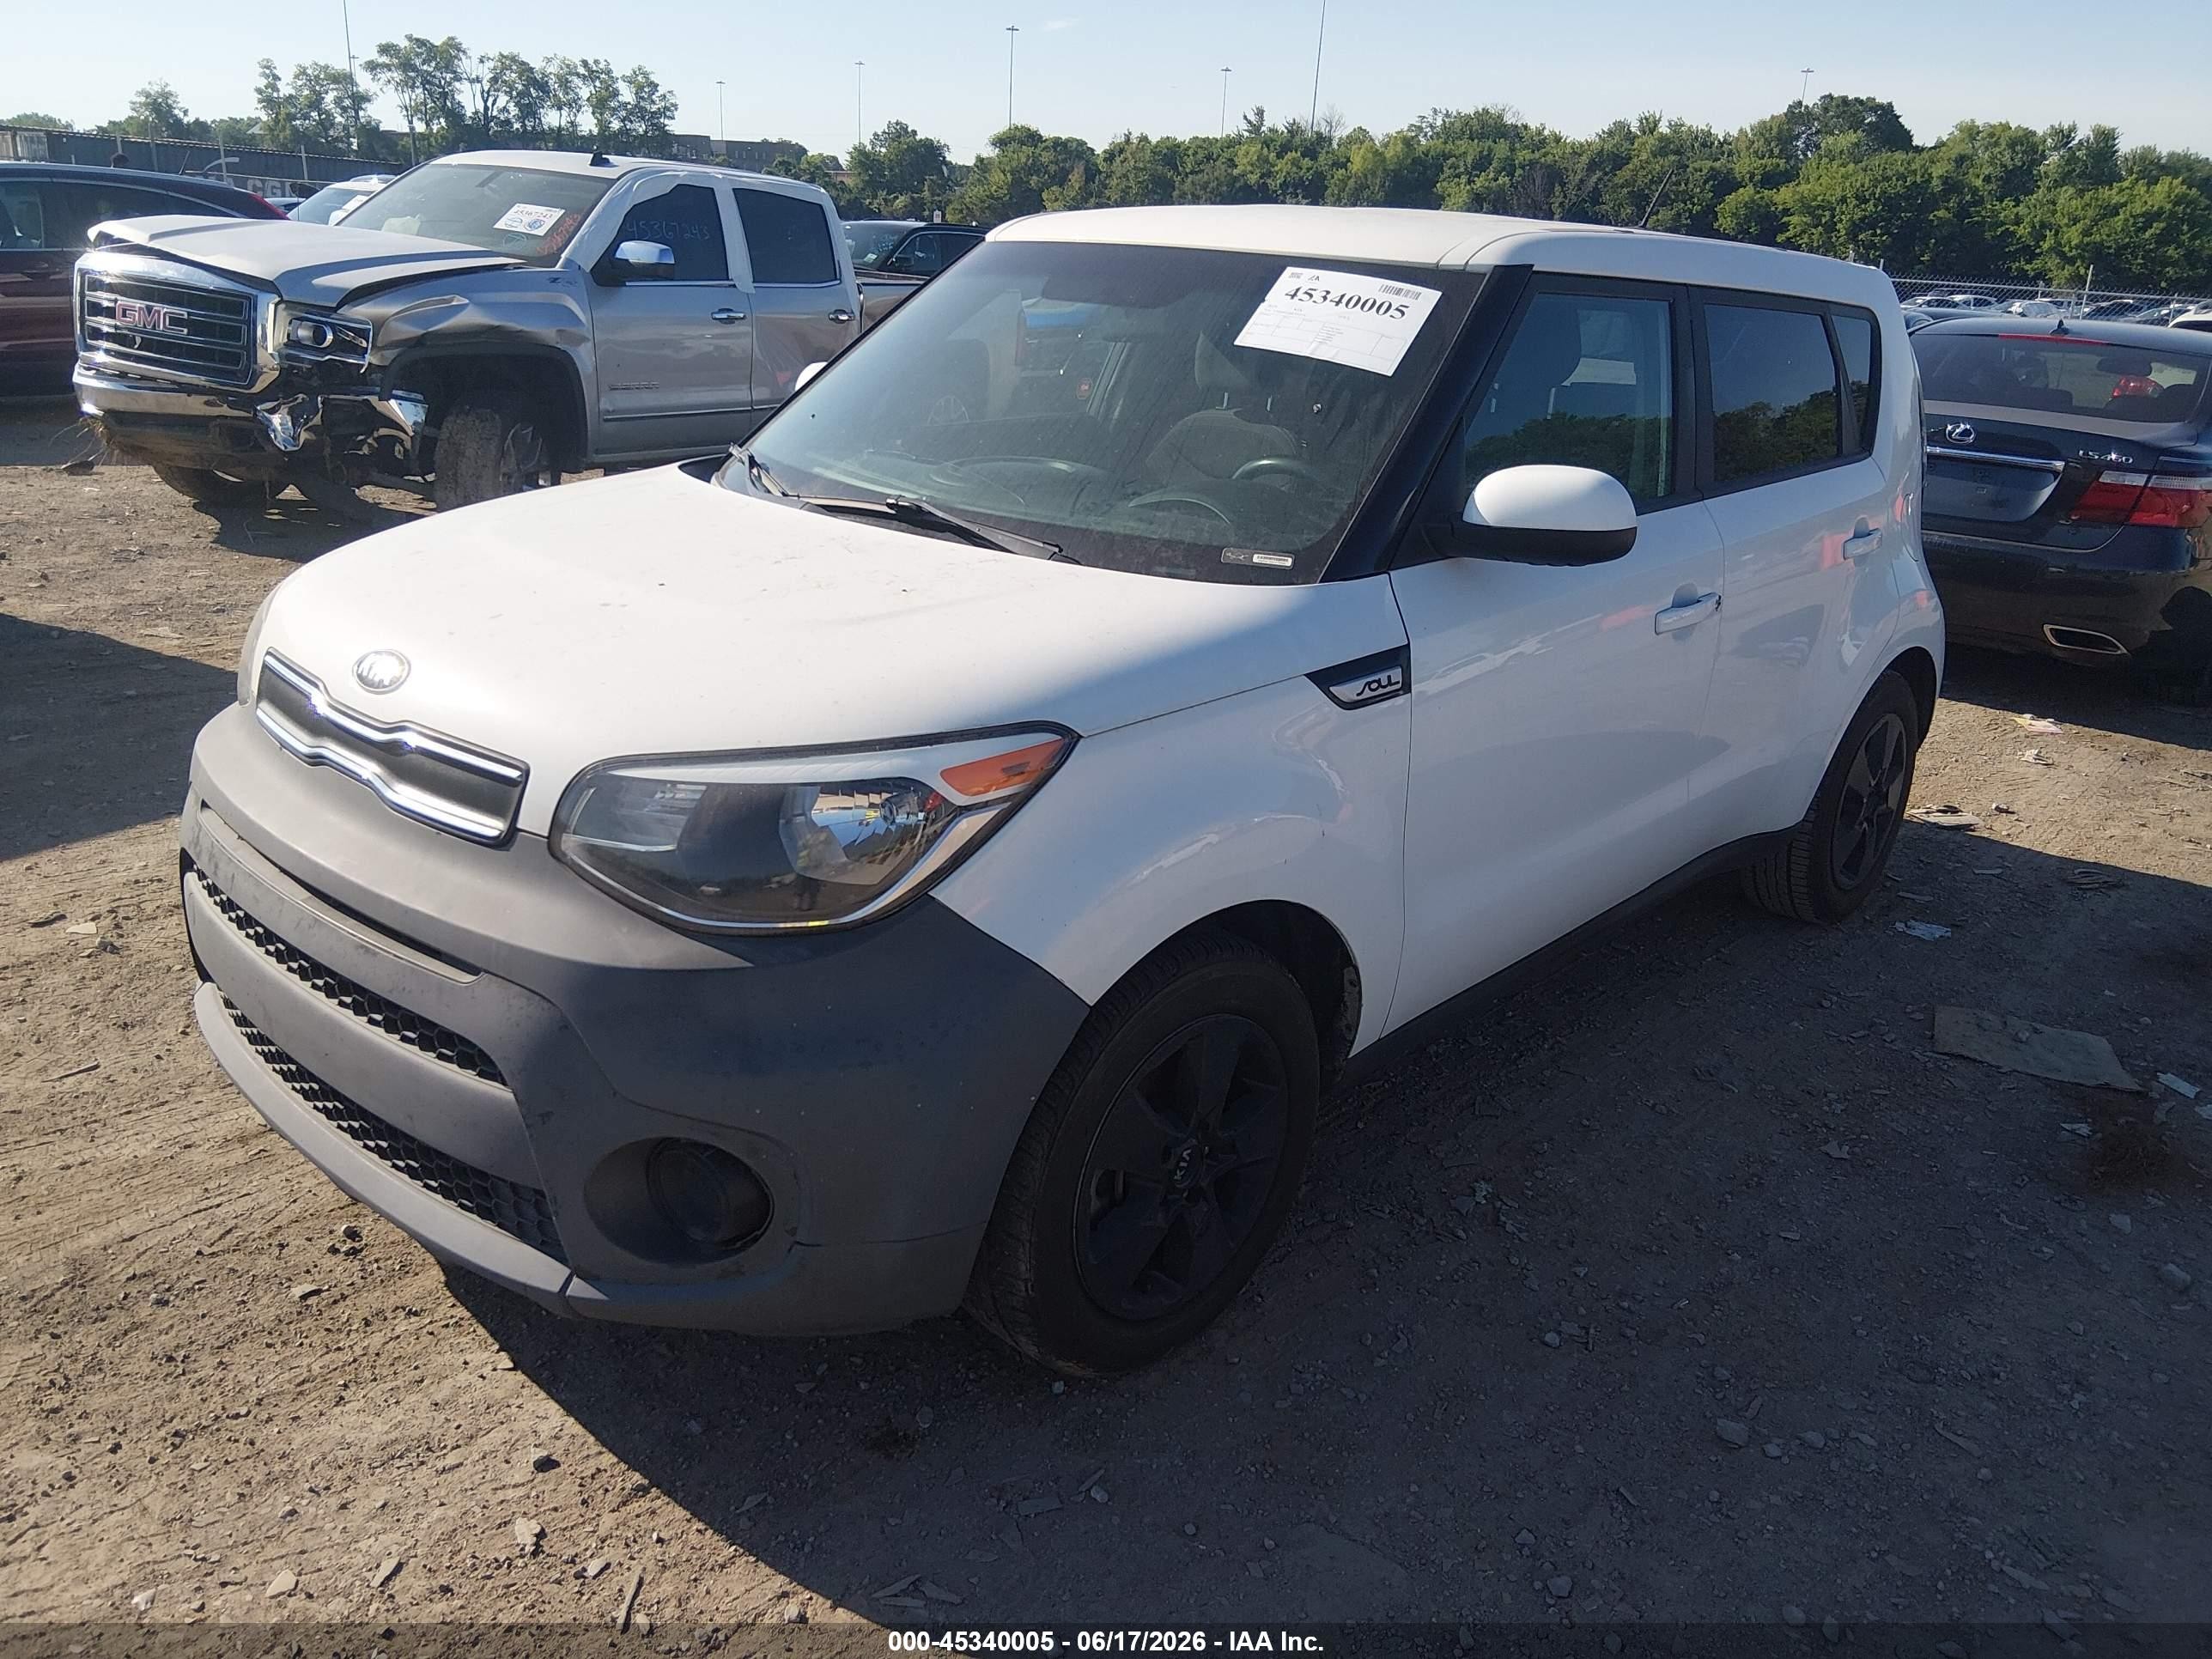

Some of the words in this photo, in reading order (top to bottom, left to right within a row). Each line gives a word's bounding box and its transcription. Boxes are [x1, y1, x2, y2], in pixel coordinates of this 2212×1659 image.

[115, 301, 188, 335] GMC
[1285, 286, 1411, 319] 45340005
[1356, 674, 1401, 697] SOUL
